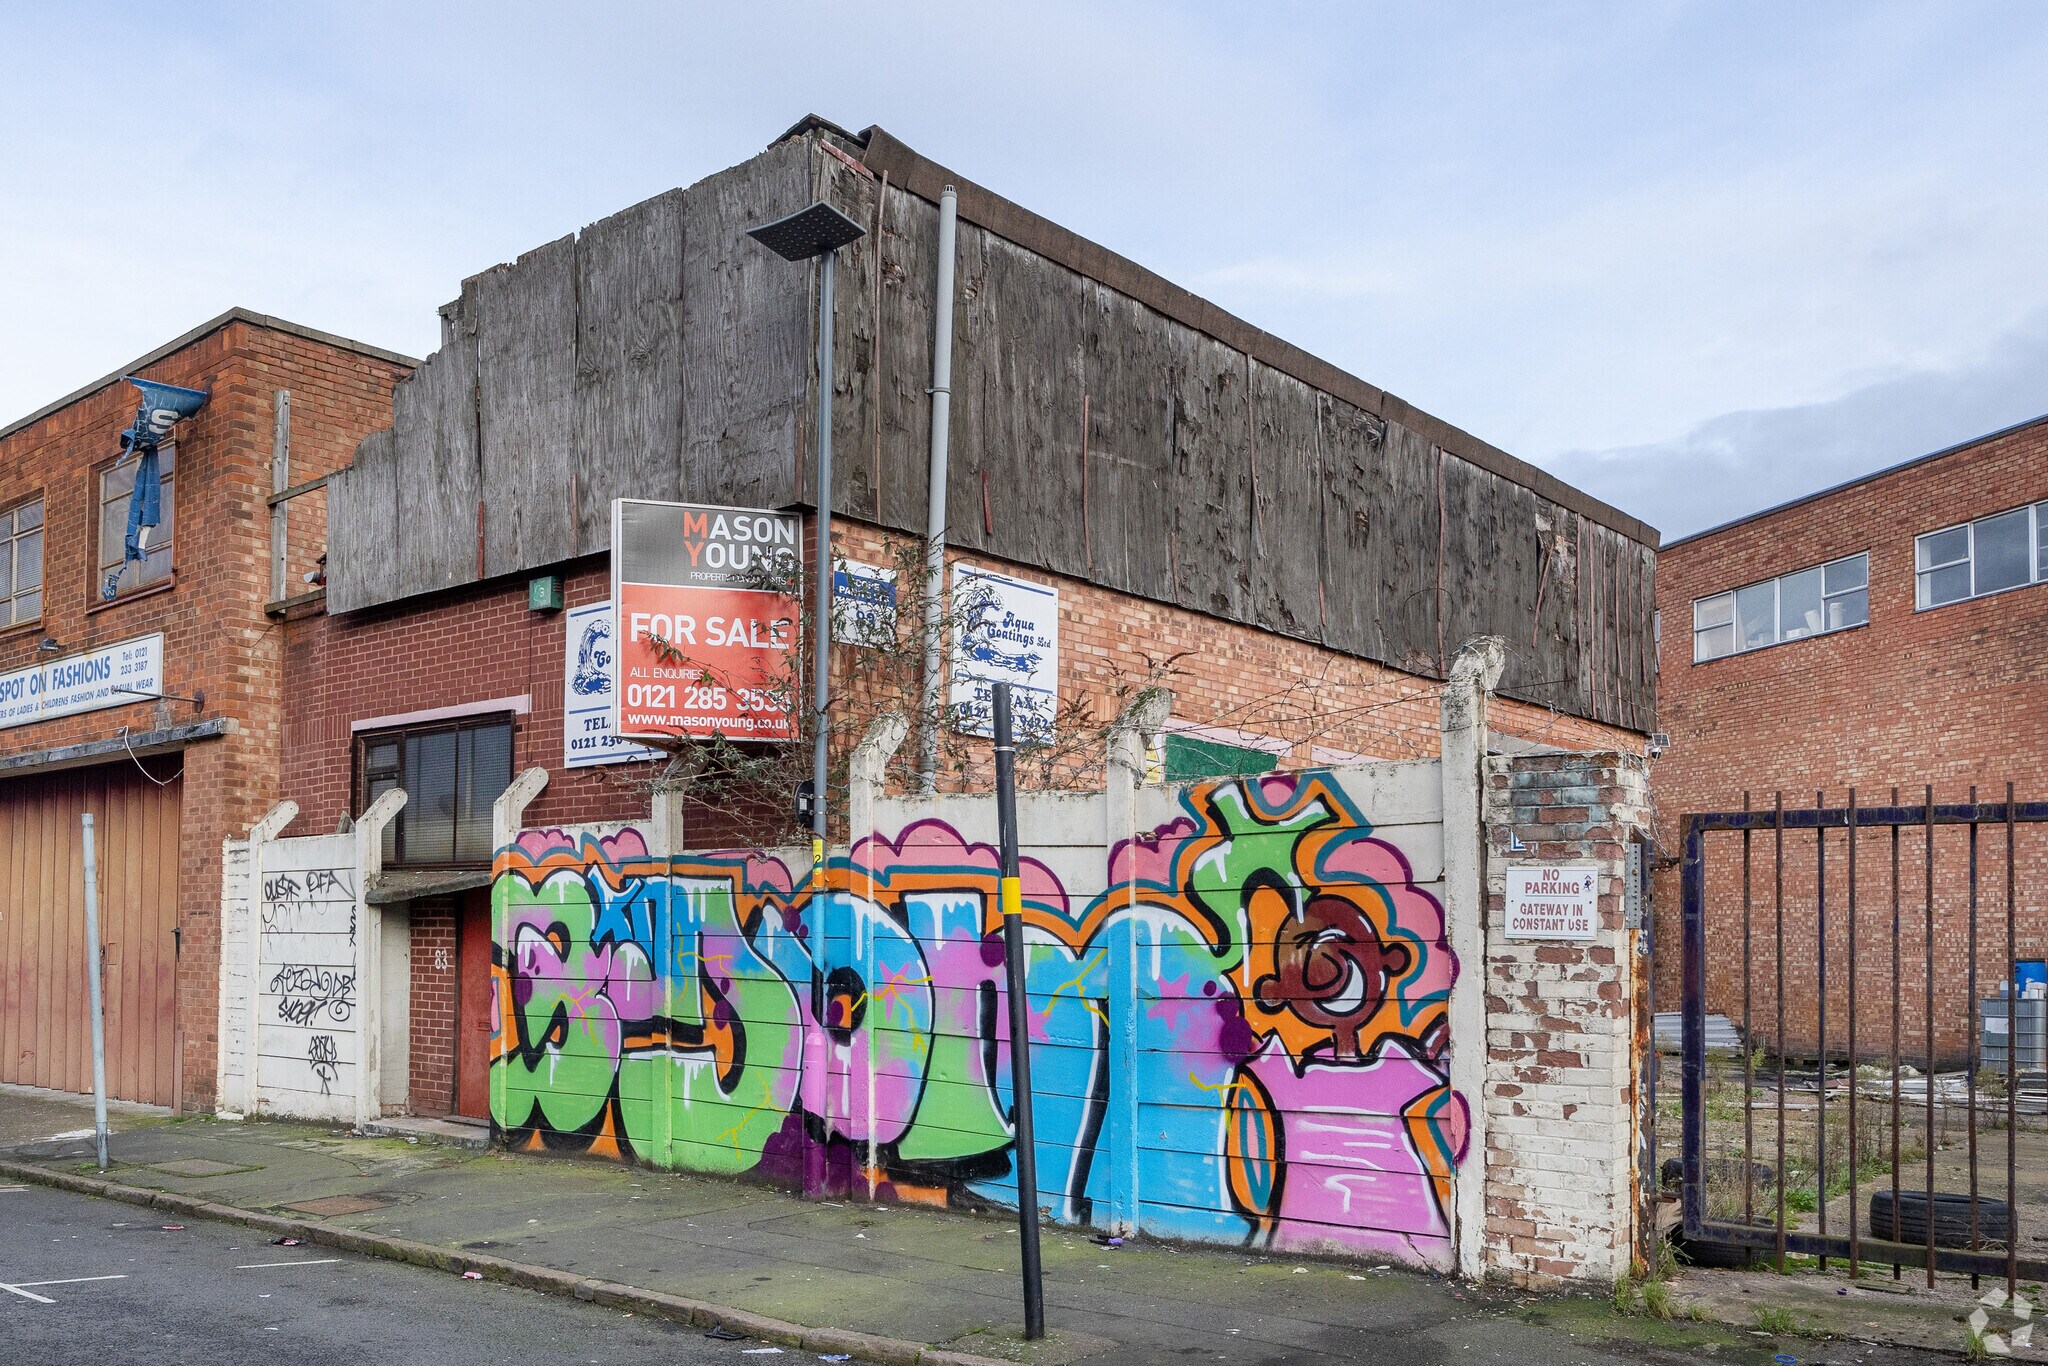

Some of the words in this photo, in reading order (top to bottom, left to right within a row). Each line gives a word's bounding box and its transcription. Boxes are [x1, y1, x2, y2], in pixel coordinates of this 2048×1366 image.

[683, 511, 795, 545] MASON
[1003, 611, 1035, 632] Aqua
[630, 612, 697, 645] FOR
[705, 616, 790, 649] SALE
[121, 664, 131, 675] 233
[134, 661, 148, 672] 3187
[630, 667, 650, 678] ALL
[654, 667, 704, 680] ENQUIRIES
[0, 677, 25, 703] SPOT
[30, 671, 47, 695] ON
[53, 655, 111, 690] FASHIONS
[9, 707, 16, 717] OF
[17, 704, 33, 715] LADIES
[35, 702, 39, 711] &
[42, 696, 69, 710] CHILDRENS
[71, 691, 94, 704] FASHION
[96, 687, 109, 698] AND
[136, 678, 153, 690] WEAR
[627, 684, 675, 708] 0121
[684, 686, 727, 710] 285
[627, 713, 790, 731] www.masonyoung.co.uk
[571, 736, 597, 750] 0121
[1542, 869, 1560, 881] NO
[1525, 882, 1580, 894] PARKING
[1520, 903, 1569, 916] GATEWAY
[1573, 904, 1583, 916] IN
[1513, 918, 1565, 930] CONSTANT
[1568, 919, 1589, 931] USE
